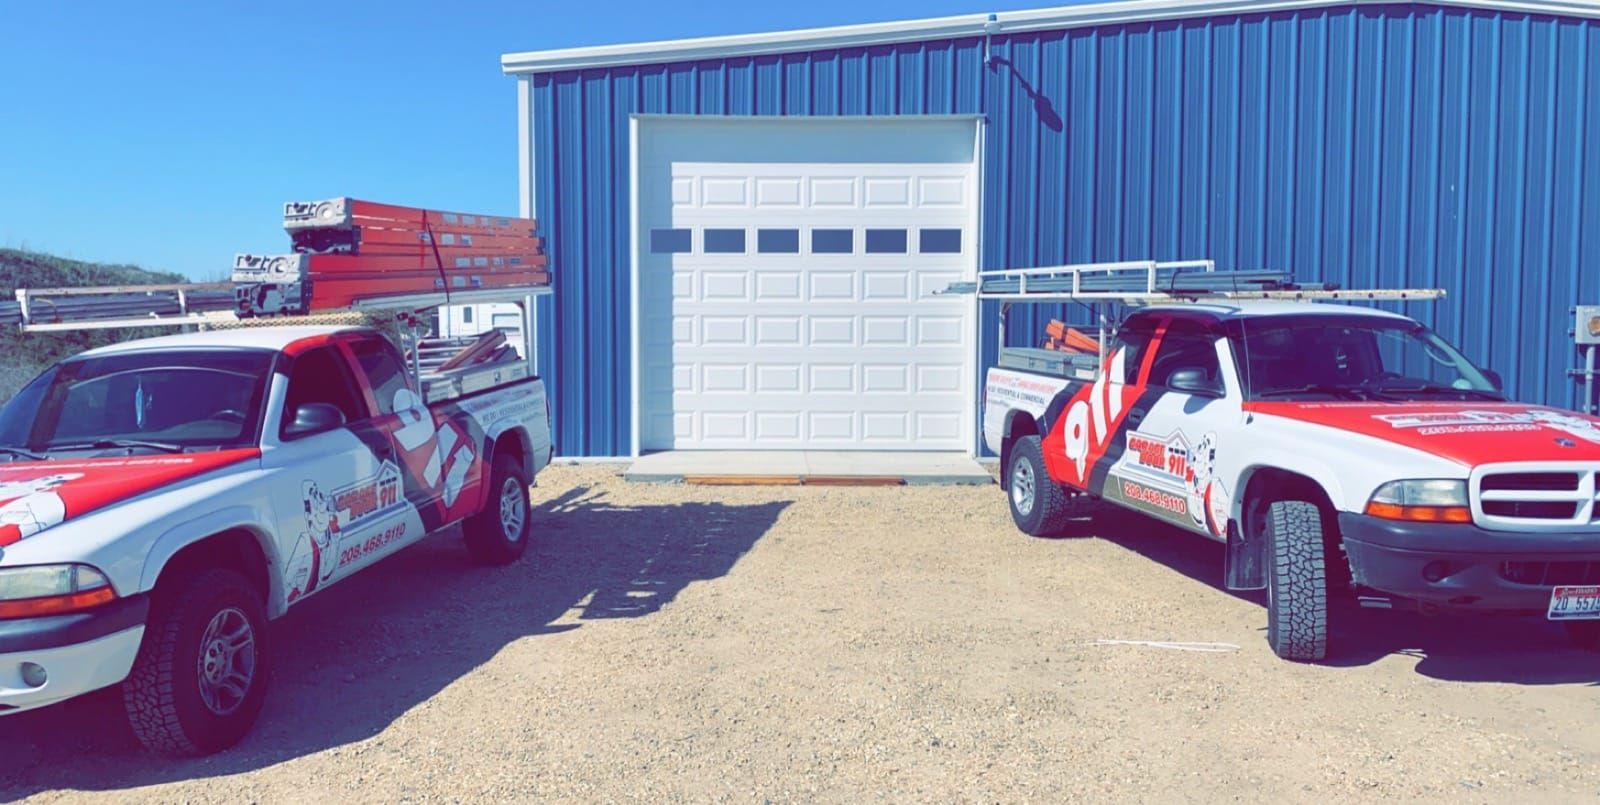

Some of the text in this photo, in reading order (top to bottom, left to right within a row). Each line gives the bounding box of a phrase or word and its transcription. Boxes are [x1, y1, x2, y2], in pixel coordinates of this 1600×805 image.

[1064, 345, 1126, 483] 911
[1128, 437, 1165, 456] GARAGE
[1138, 451, 1165, 470] DOOR
[1168, 454, 1186, 477] 911
[380, 483, 397, 508] 911
[1124, 480, 1187, 514] 208.468.9110
[339, 521, 406, 566] 208.468.9110
